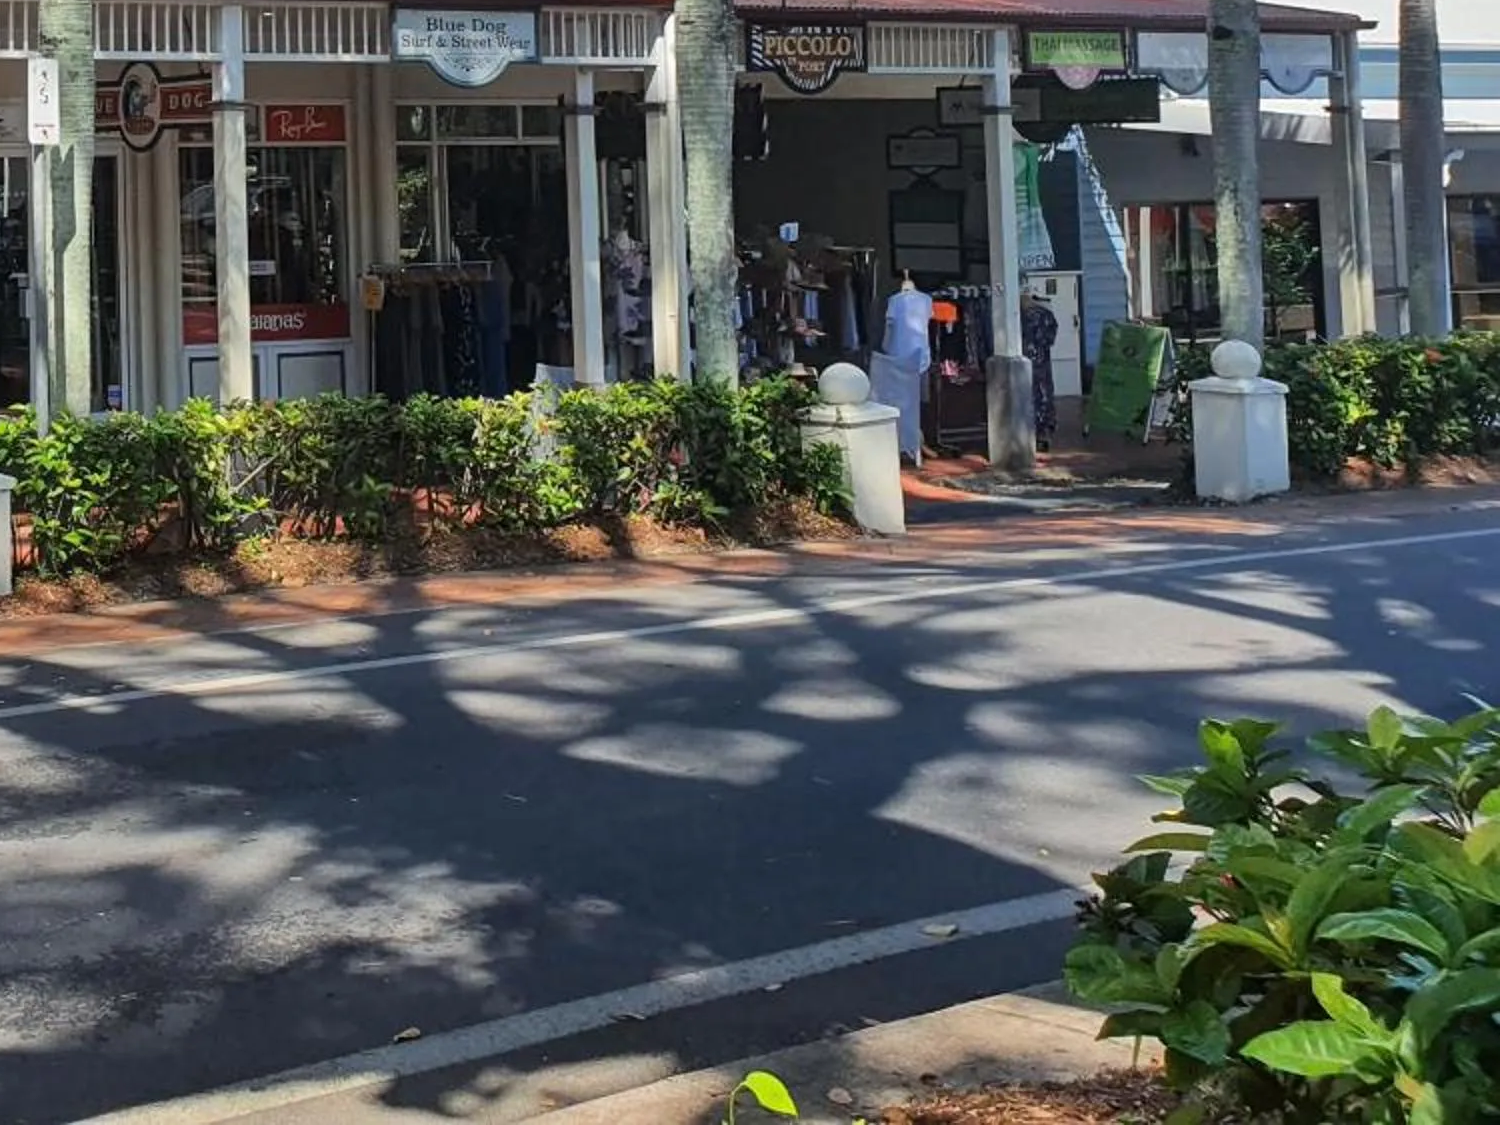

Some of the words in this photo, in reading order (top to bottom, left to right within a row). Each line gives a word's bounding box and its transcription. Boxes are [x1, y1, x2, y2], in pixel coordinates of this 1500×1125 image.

[425, 16, 465, 32] Blue
[471, 18, 507, 35] Dog
[402, 34, 432, 48] Surf
[436, 35, 447, 48] &
[451, 34, 493, 49] Street
[496, 36, 531, 50] Wear
[764, 36, 851, 56] PICCOLO
[168, 92, 205, 111] DOG
